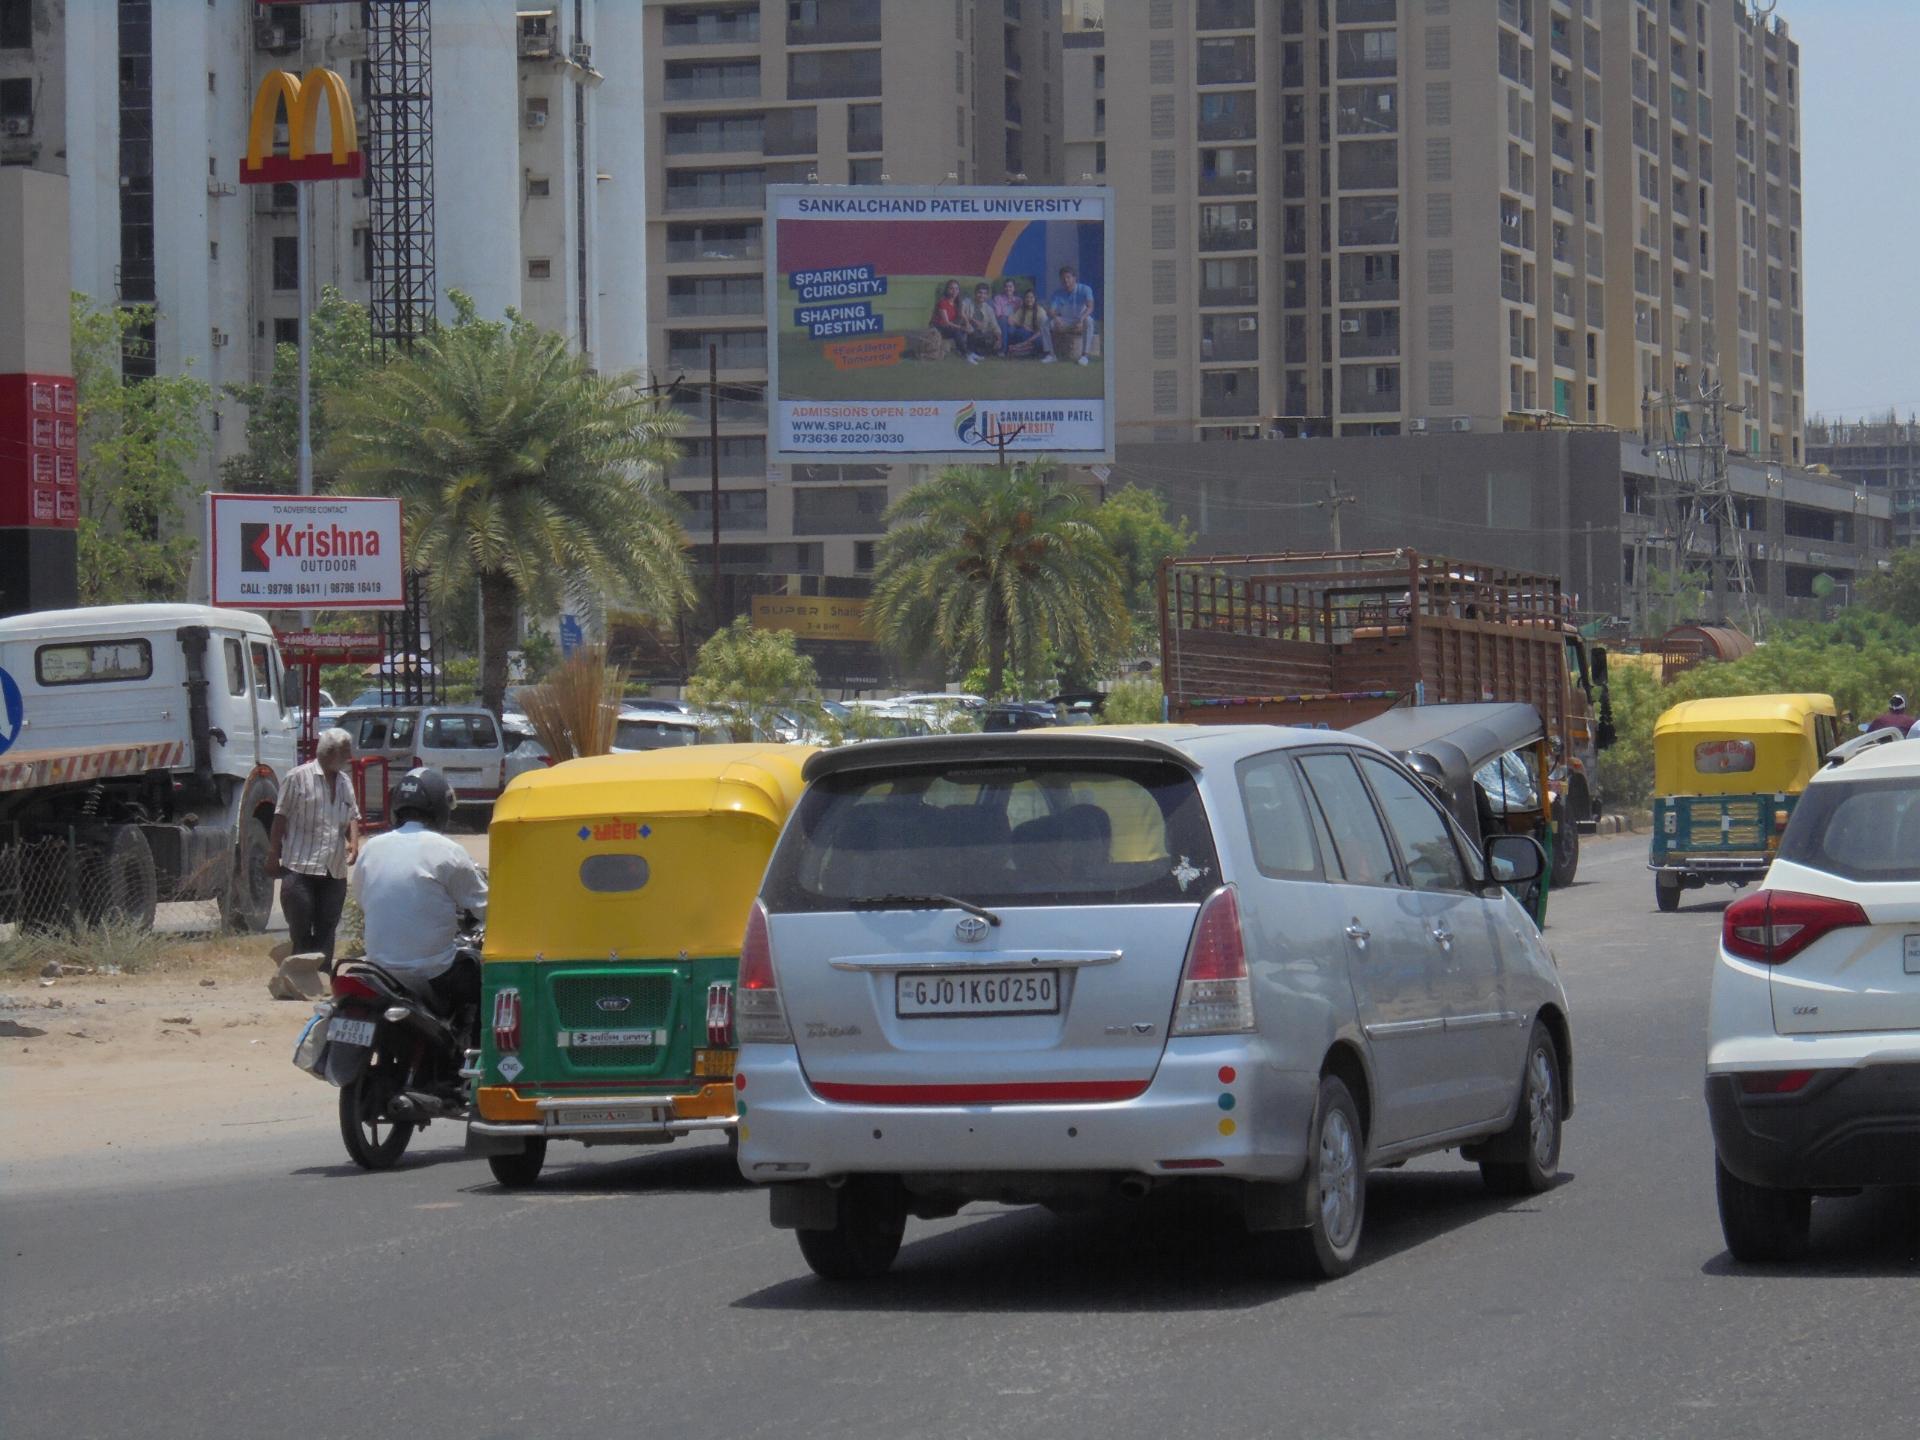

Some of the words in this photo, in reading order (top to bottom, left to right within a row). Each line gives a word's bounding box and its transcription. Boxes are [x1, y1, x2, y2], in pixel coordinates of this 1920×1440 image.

[799, 199, 927, 213] SANKALCHAND
[931, 199, 979, 213] PATEL
[984, 198, 1082, 213] UNIVERSITY
[795, 267, 868, 286] SPARKING
[803, 280, 882, 299] CURIOSITY,
[800, 305, 865, 323] SHAPING
[814, 318, 878, 336] DESTINY.
[792, 407, 868, 417] ADMISSIONS
[871, 407, 904, 417] OPEN
[909, 407, 939, 417] 2024
[1000, 411, 1064, 422] SANKALCHAND
[1067, 410, 1094, 421] PATEL
[792, 421, 886, 431] WWW.SPU.AC.IN
[793, 434, 837, 443] 973636
[841, 433, 904, 443] 2020/3030
[273, 506, 282, 514] TO
[283, 506, 317, 514] ADVERTISE
[275, 523, 380, 557] Krishna
[301, 560, 357, 572] OUTDOOR
[240, 584, 260, 594] CALL
[760, 606, 819, 616] SUPER
[915, 978, 1051, 1005] GJ01KG0250
[502, 1063, 518, 1071] CNG
